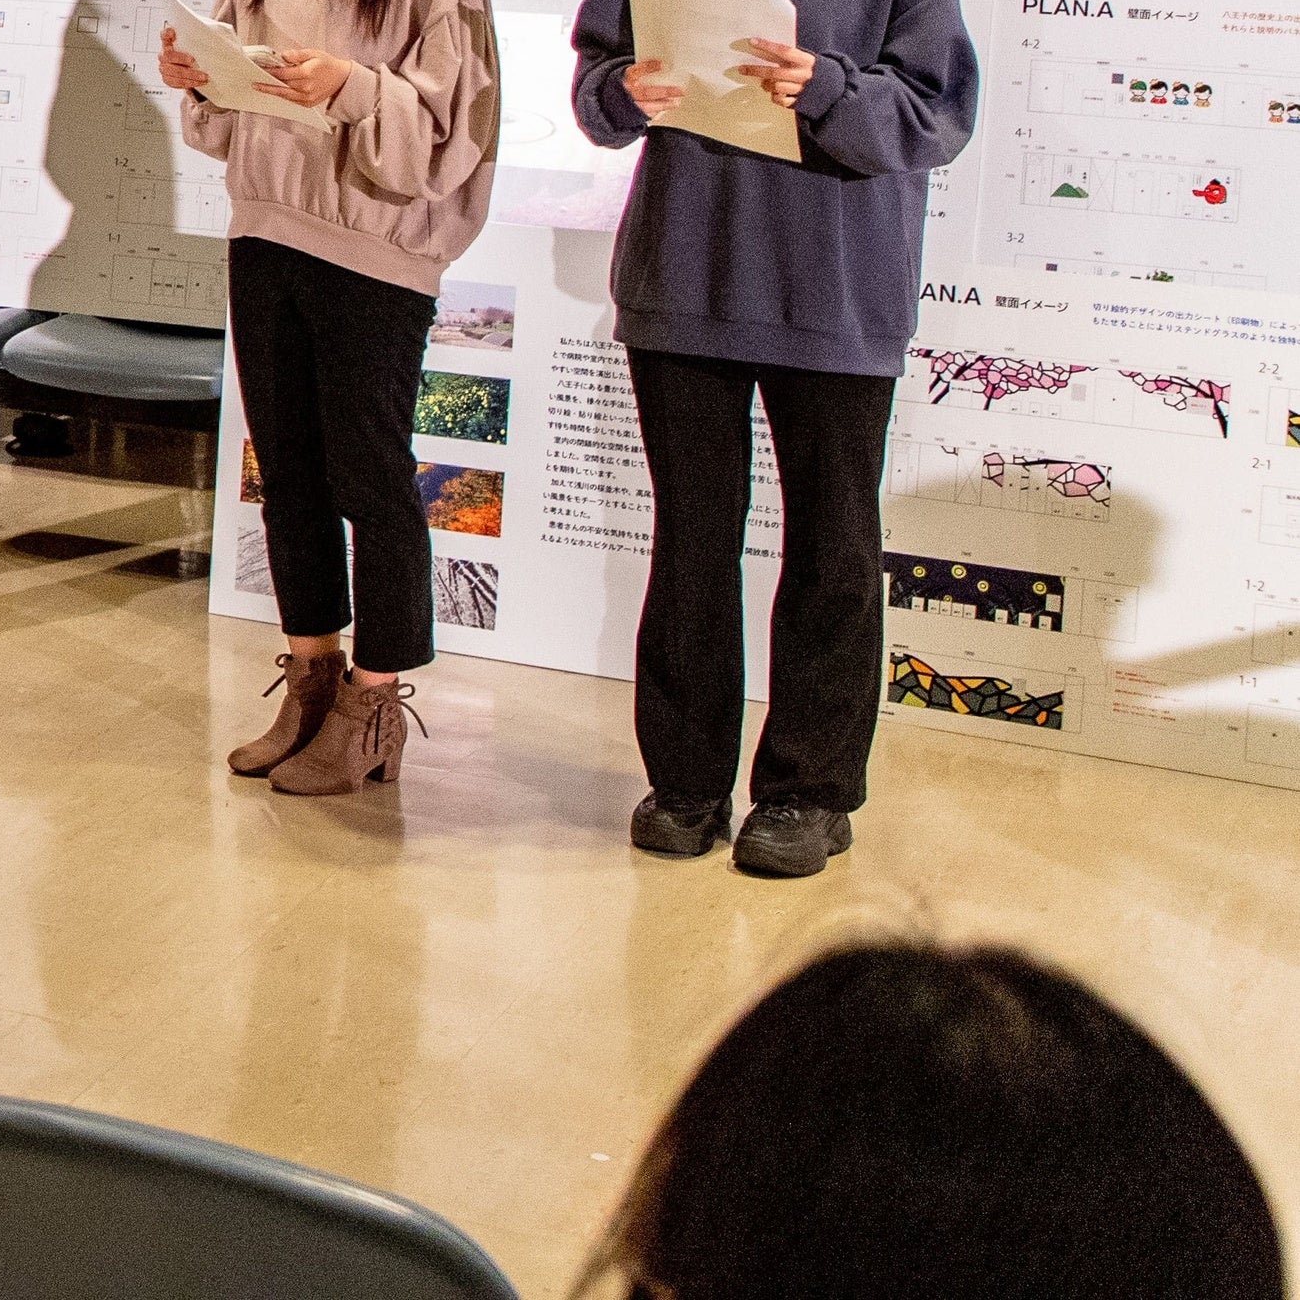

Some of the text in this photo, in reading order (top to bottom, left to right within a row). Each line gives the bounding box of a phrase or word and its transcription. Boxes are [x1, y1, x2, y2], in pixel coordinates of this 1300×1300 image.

[1127, 8, 1199, 21] 壁面イメージ
[1021, 39, 1040, 49] 4-2
[122, 63, 136, 72] 2-1
[1015, 128, 1032, 138] 4-1
[114, 158, 128, 167] 1-2
[107, 233, 121, 242] 1-1
[1006, 232, 1024, 243] 3-2
[919, 282, 1069, 313] AN.A 壁面イメージ
[1093, 303, 1300, 331] 切り絵的デザインの出力シート（印刷物）によっ
[1259, 362, 1280, 375] 2-2
[548, 421, 642, 439] す待ち時間を少しでも楽し
[1252, 458, 1271, 470] 2-1
[548, 520, 653, 541] 患者さんの不安な気持ちを取
[1245, 580, 1265, 592] 1-2
[1239, 675, 1258, 688] 1-1
